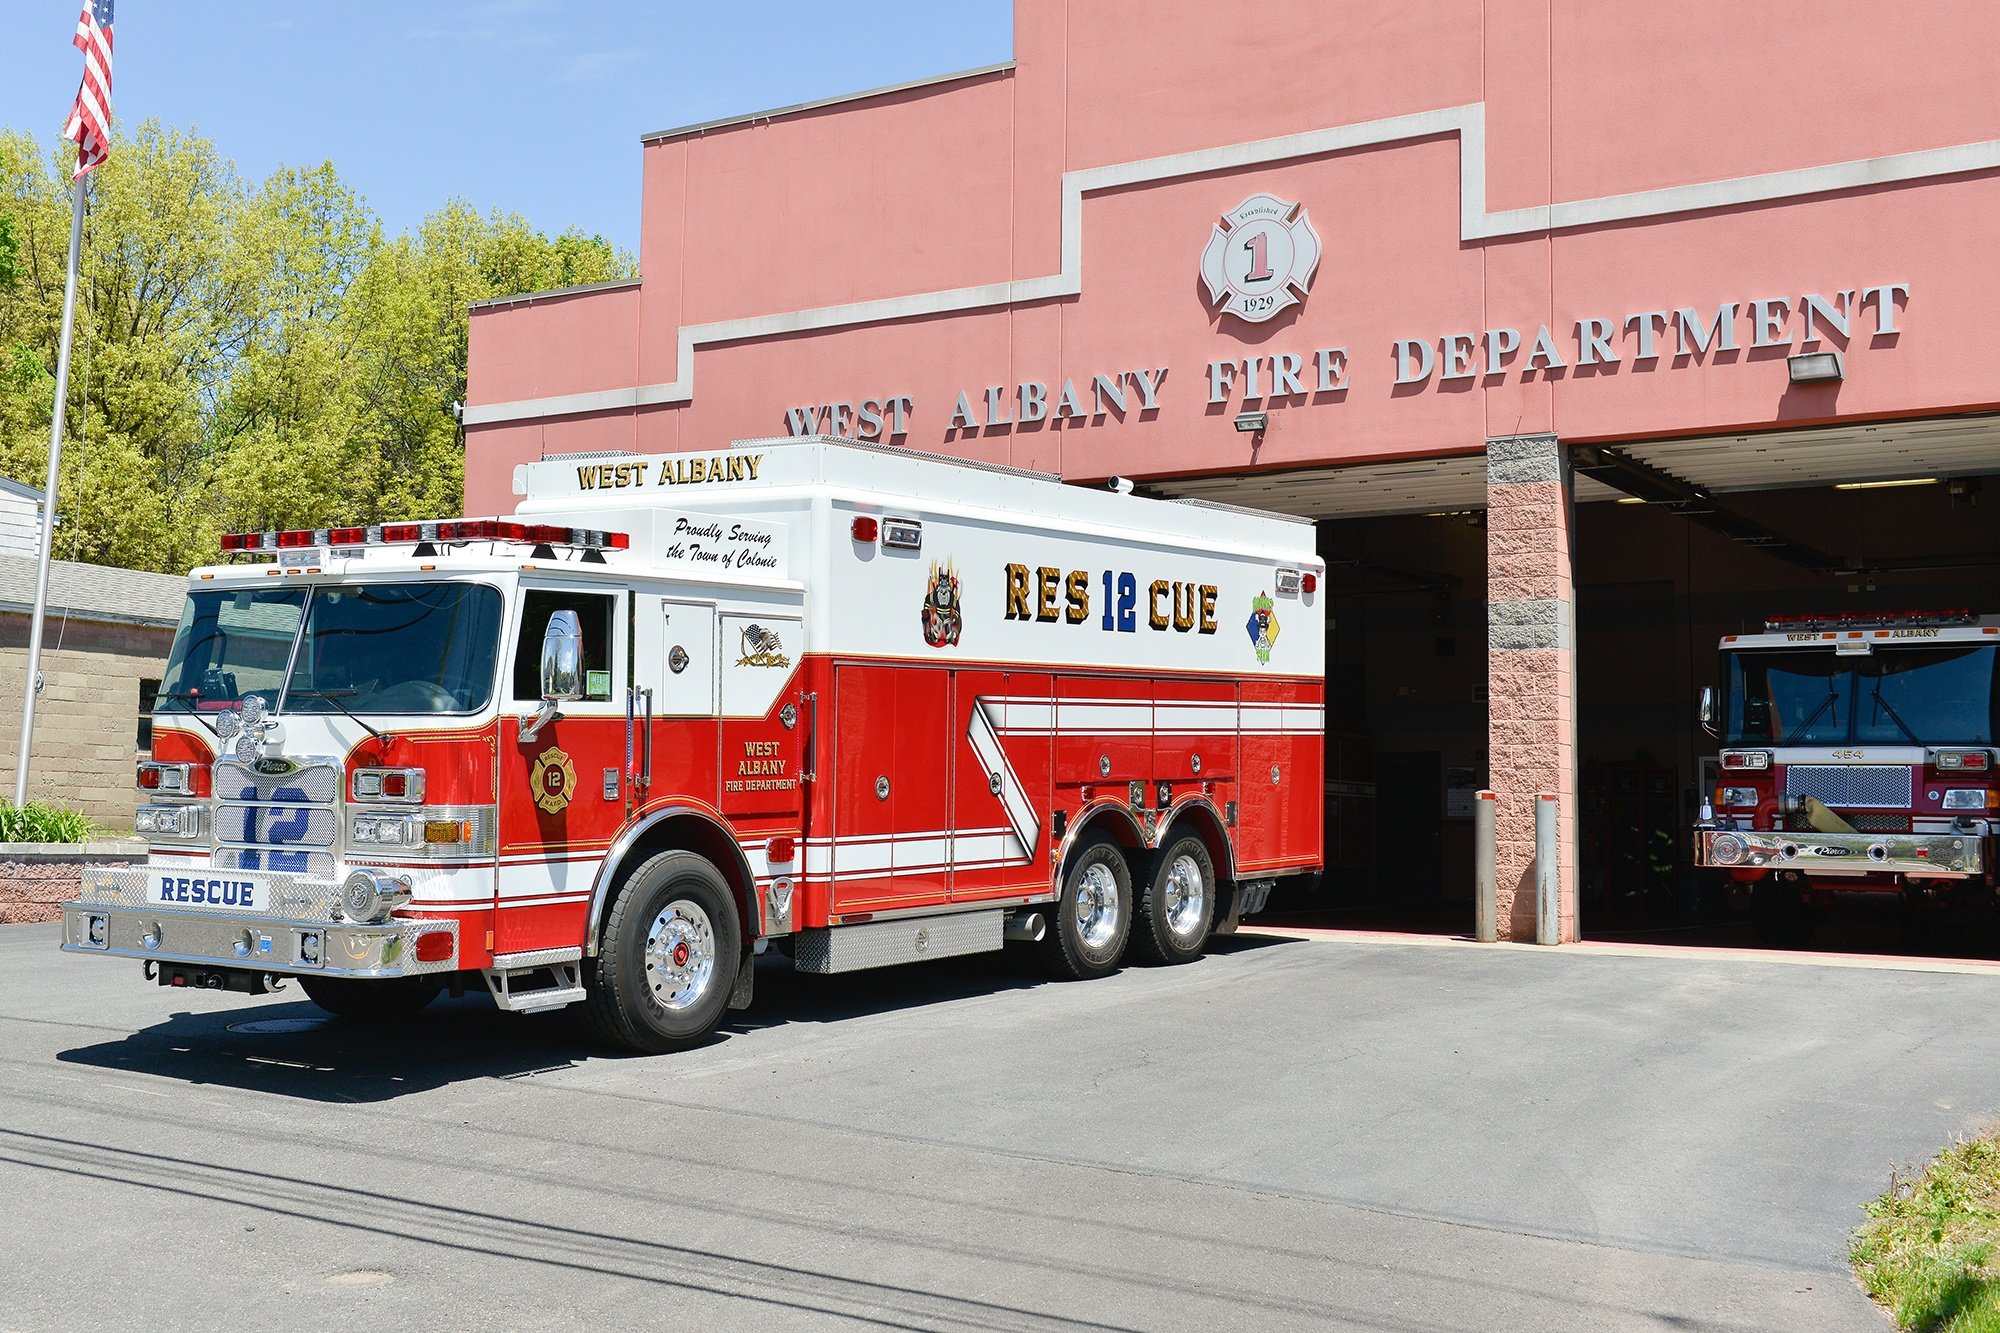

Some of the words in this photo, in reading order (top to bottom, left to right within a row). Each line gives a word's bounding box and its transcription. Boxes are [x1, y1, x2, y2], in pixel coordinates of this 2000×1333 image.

[1239, 206, 1279, 220] Established
[1243, 231, 1275, 284] 1
[1243, 296, 1275, 312] 1929
[785, 396, 914, 439] WEST
[946, 367, 1169, 430] ALBANY
[1207, 347, 1350, 404] FIRE
[1393, 282, 1910, 385] DEPARTMENT
[576, 461, 648, 490] WEST
[658, 454, 764, 486] ALBANY
[673, 517, 723, 543] Proudly
[727, 524, 772, 550] Serving
[666, 542, 685, 559] the
[689, 543, 719, 562] Town
[721, 549, 736, 569] of
[736, 548, 778, 569] Colonie
[1003, 562, 1089, 625] RES
[1101, 569, 1137, 633] 12
[1147, 579, 1218, 635] CUE
[1786, 632, 1820, 642] WEST
[1892, 628, 1941, 639] ALBANY
[545, 753, 563, 761] RESCUE
[744, 741, 780, 757] WEST
[1832, 750, 1864, 759] 454
[258, 759, 287, 773] Pierce
[737, 759, 787, 776] ALBANY
[547, 771, 561, 787] 12
[724, 780, 744, 792] FIRE
[745, 778, 797, 791] DEPARTMENT
[239, 786, 312, 874] 12
[1818, 846, 1848, 857] Pierce
[159, 876, 255, 907] RESCUE
